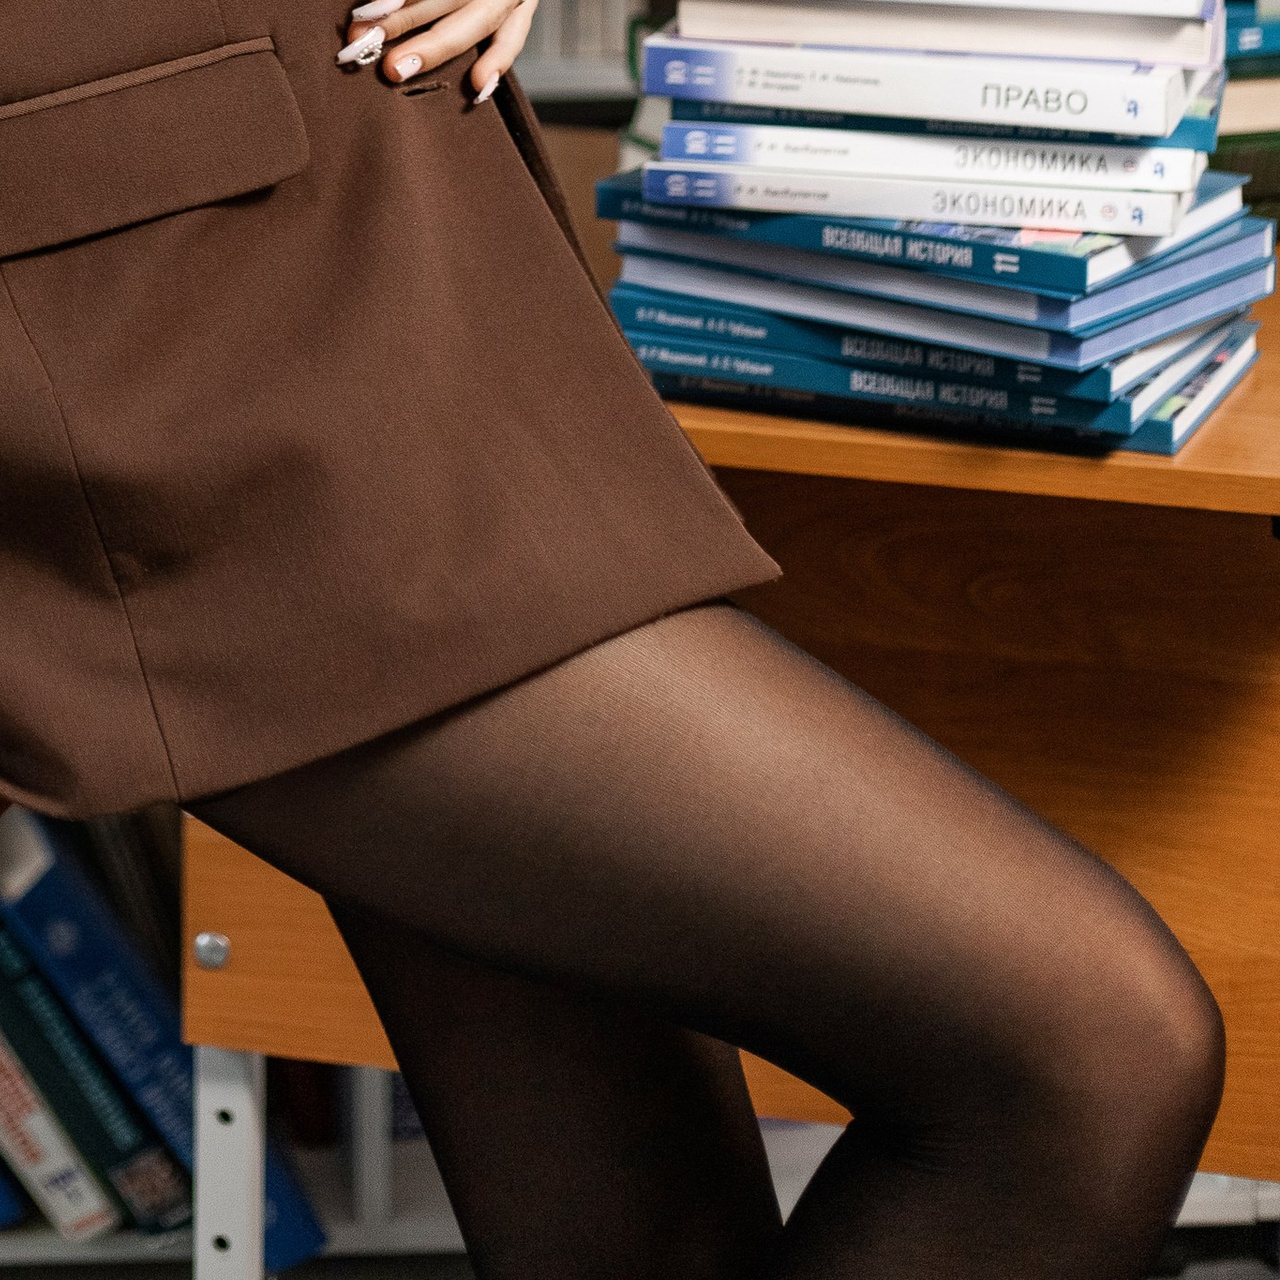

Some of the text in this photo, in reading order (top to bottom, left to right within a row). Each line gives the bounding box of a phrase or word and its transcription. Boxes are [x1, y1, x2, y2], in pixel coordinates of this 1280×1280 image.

[981, 82, 1089, 116] ПРАВО
[954, 144, 1109, 174] ЭКОНОМИКА
[931, 190, 1088, 219] ЭКОНОМИКА
[822, 226, 902, 258] ВСЕОБЩАЯ
[906, 241, 974, 268] ИСТОРИЯ
[928, 349, 995, 377] ИСТОРИЯ
[939, 383, 1008, 410] ИСТОРИЯ
